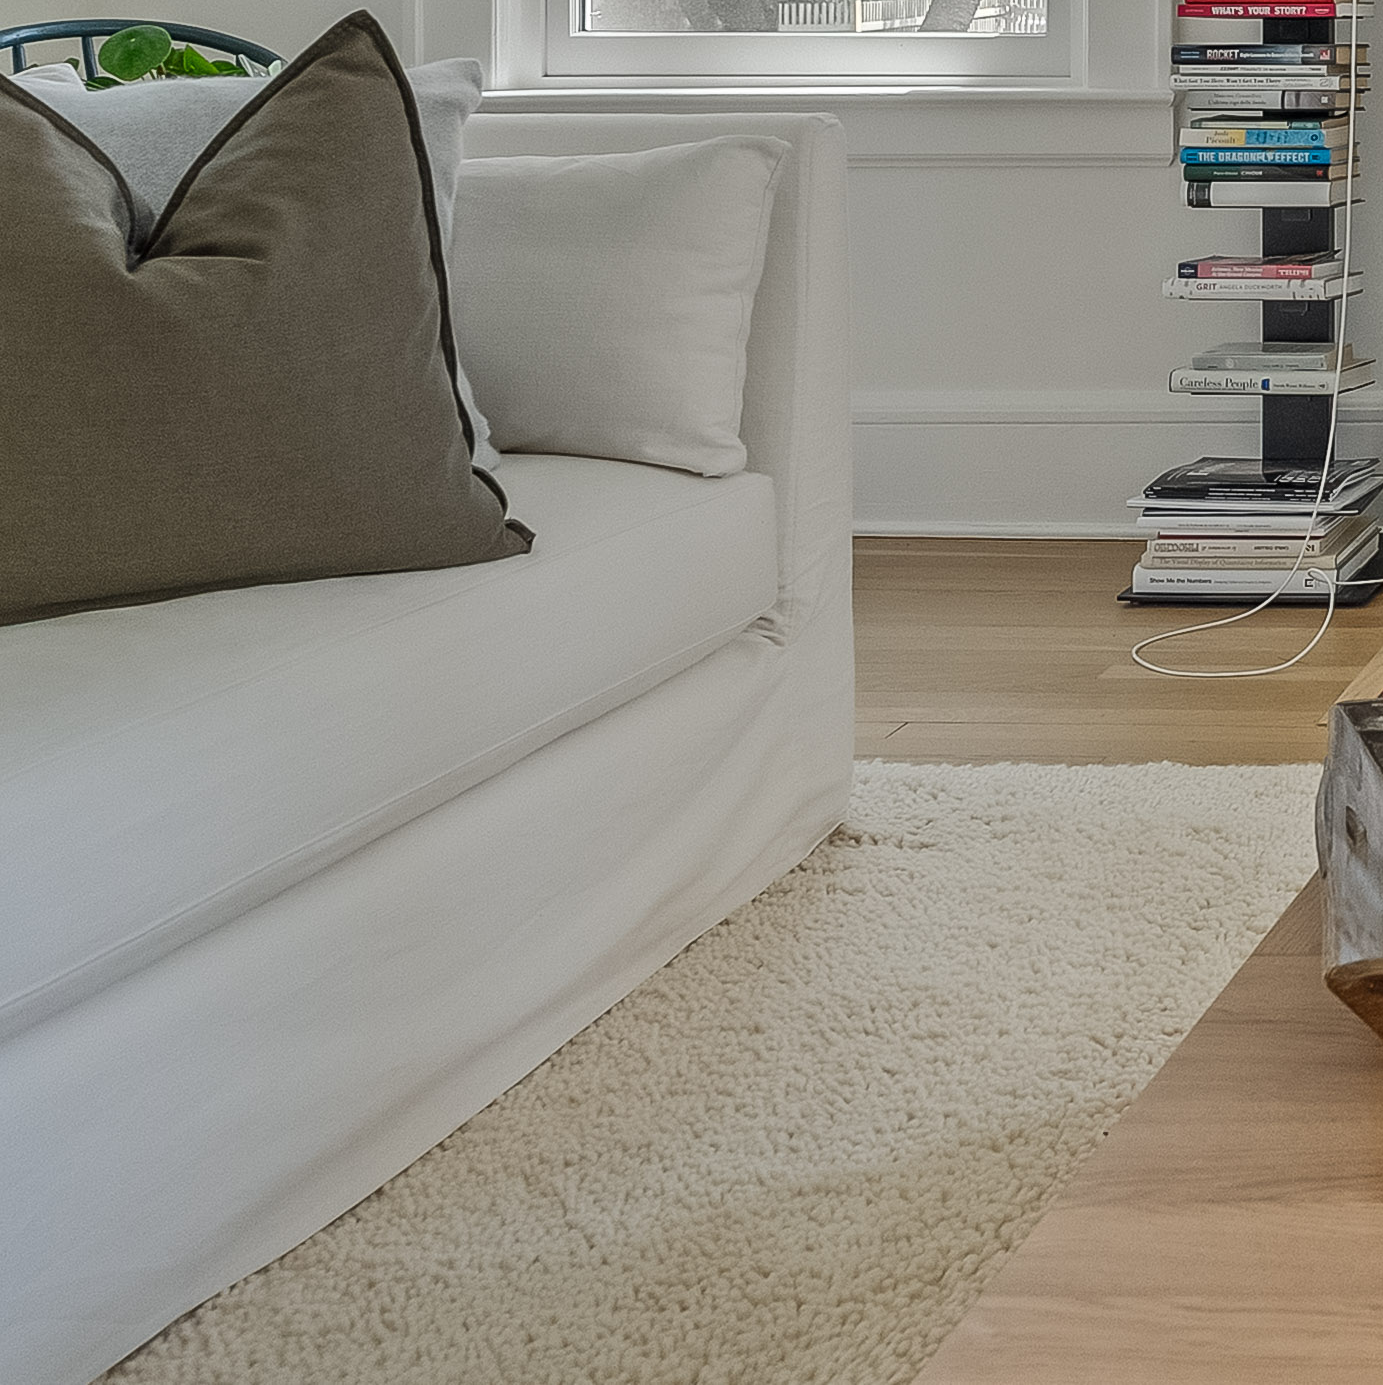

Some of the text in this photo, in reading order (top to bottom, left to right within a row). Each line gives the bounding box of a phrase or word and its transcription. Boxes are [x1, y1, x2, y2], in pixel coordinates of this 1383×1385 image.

[1211, 6, 1307, 15] WHAT'S YOUR STORY?
[1206, 49, 1240, 60] ROCKET
[1205, 136, 1236, 145] Picoult
[1199, 151, 1310, 162] THE DRAGONFLY EFFECT
[1196, 283, 1218, 291] GRIT
[1179, 376, 1259, 390] Careless People
